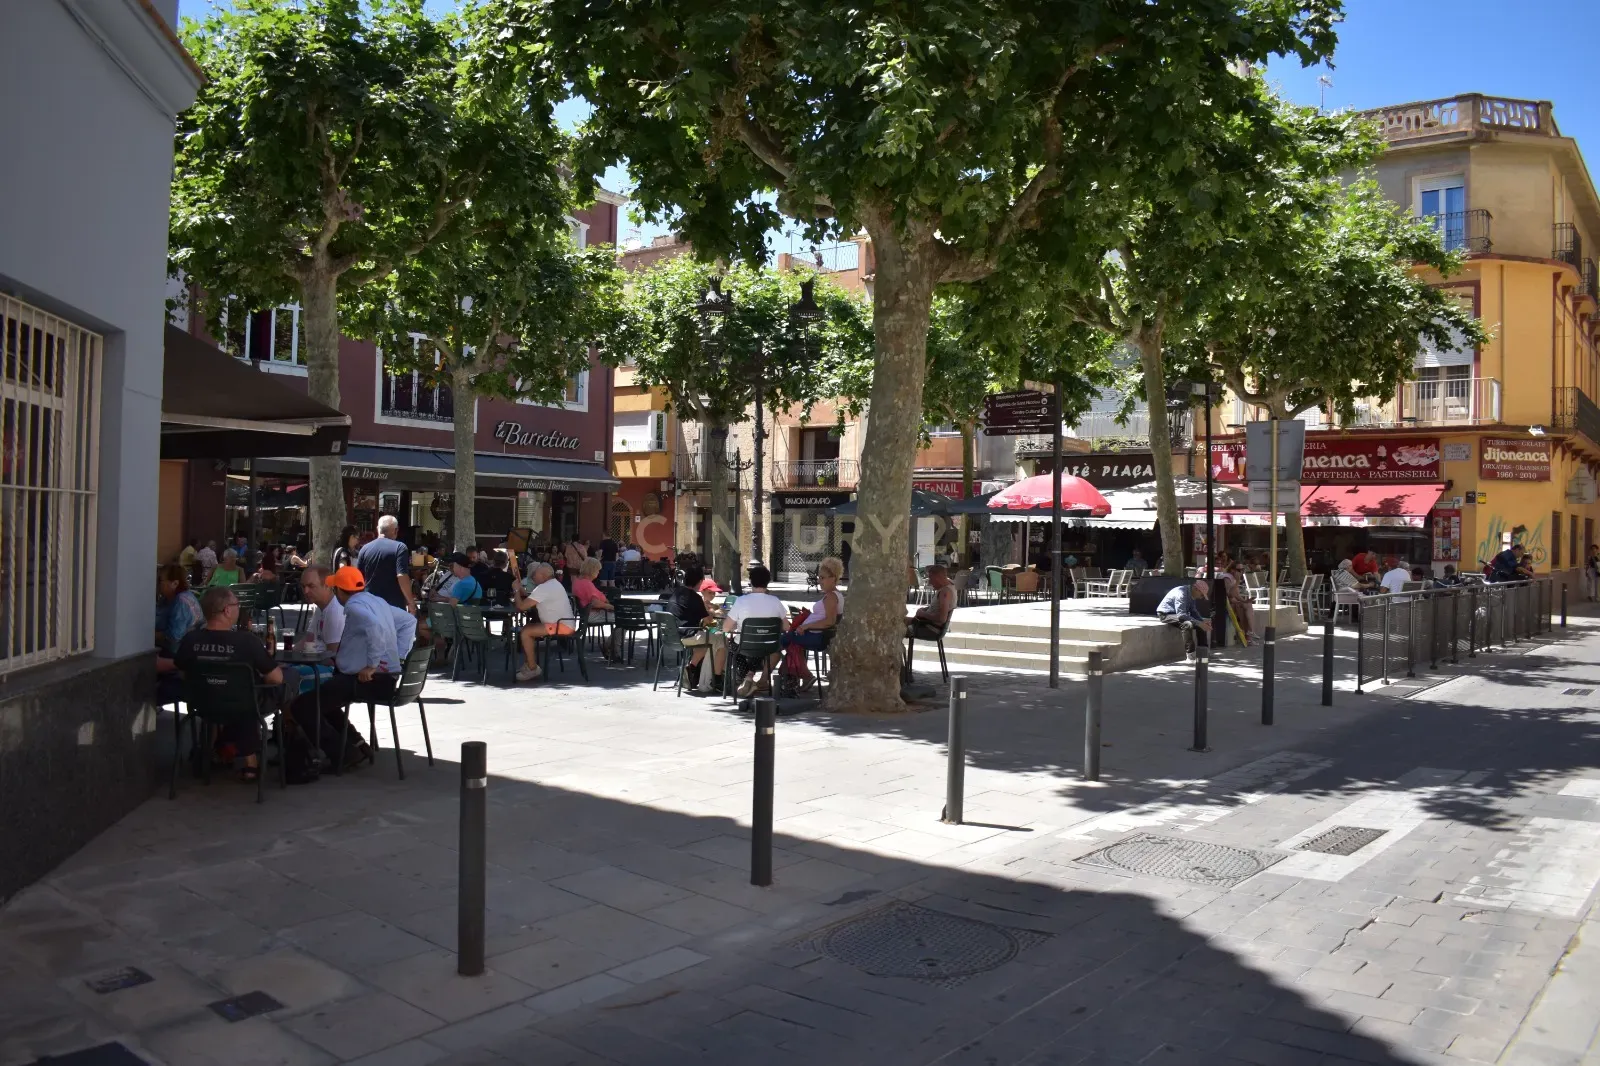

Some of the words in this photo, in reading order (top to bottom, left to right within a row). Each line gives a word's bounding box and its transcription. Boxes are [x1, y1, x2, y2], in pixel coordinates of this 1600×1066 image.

[504, 422, 580, 450] Barretina
[1303, 442, 1328, 450] ERIA
[1484, 447, 1549, 462] Jijonenca
[350, 467, 360, 477] la
[362, 468, 388, 479] Brasa
[1062, 462, 1090, 477] AFÈ
[1102, 465, 1154, 478] PLAÇA
[1303, 471, 1360, 479] CAFETERIA
[1369, 470, 1438, 479] PASTISSERIA
[517, 480, 546, 490] Embotits
[193, 643, 236, 653] GUIDE
